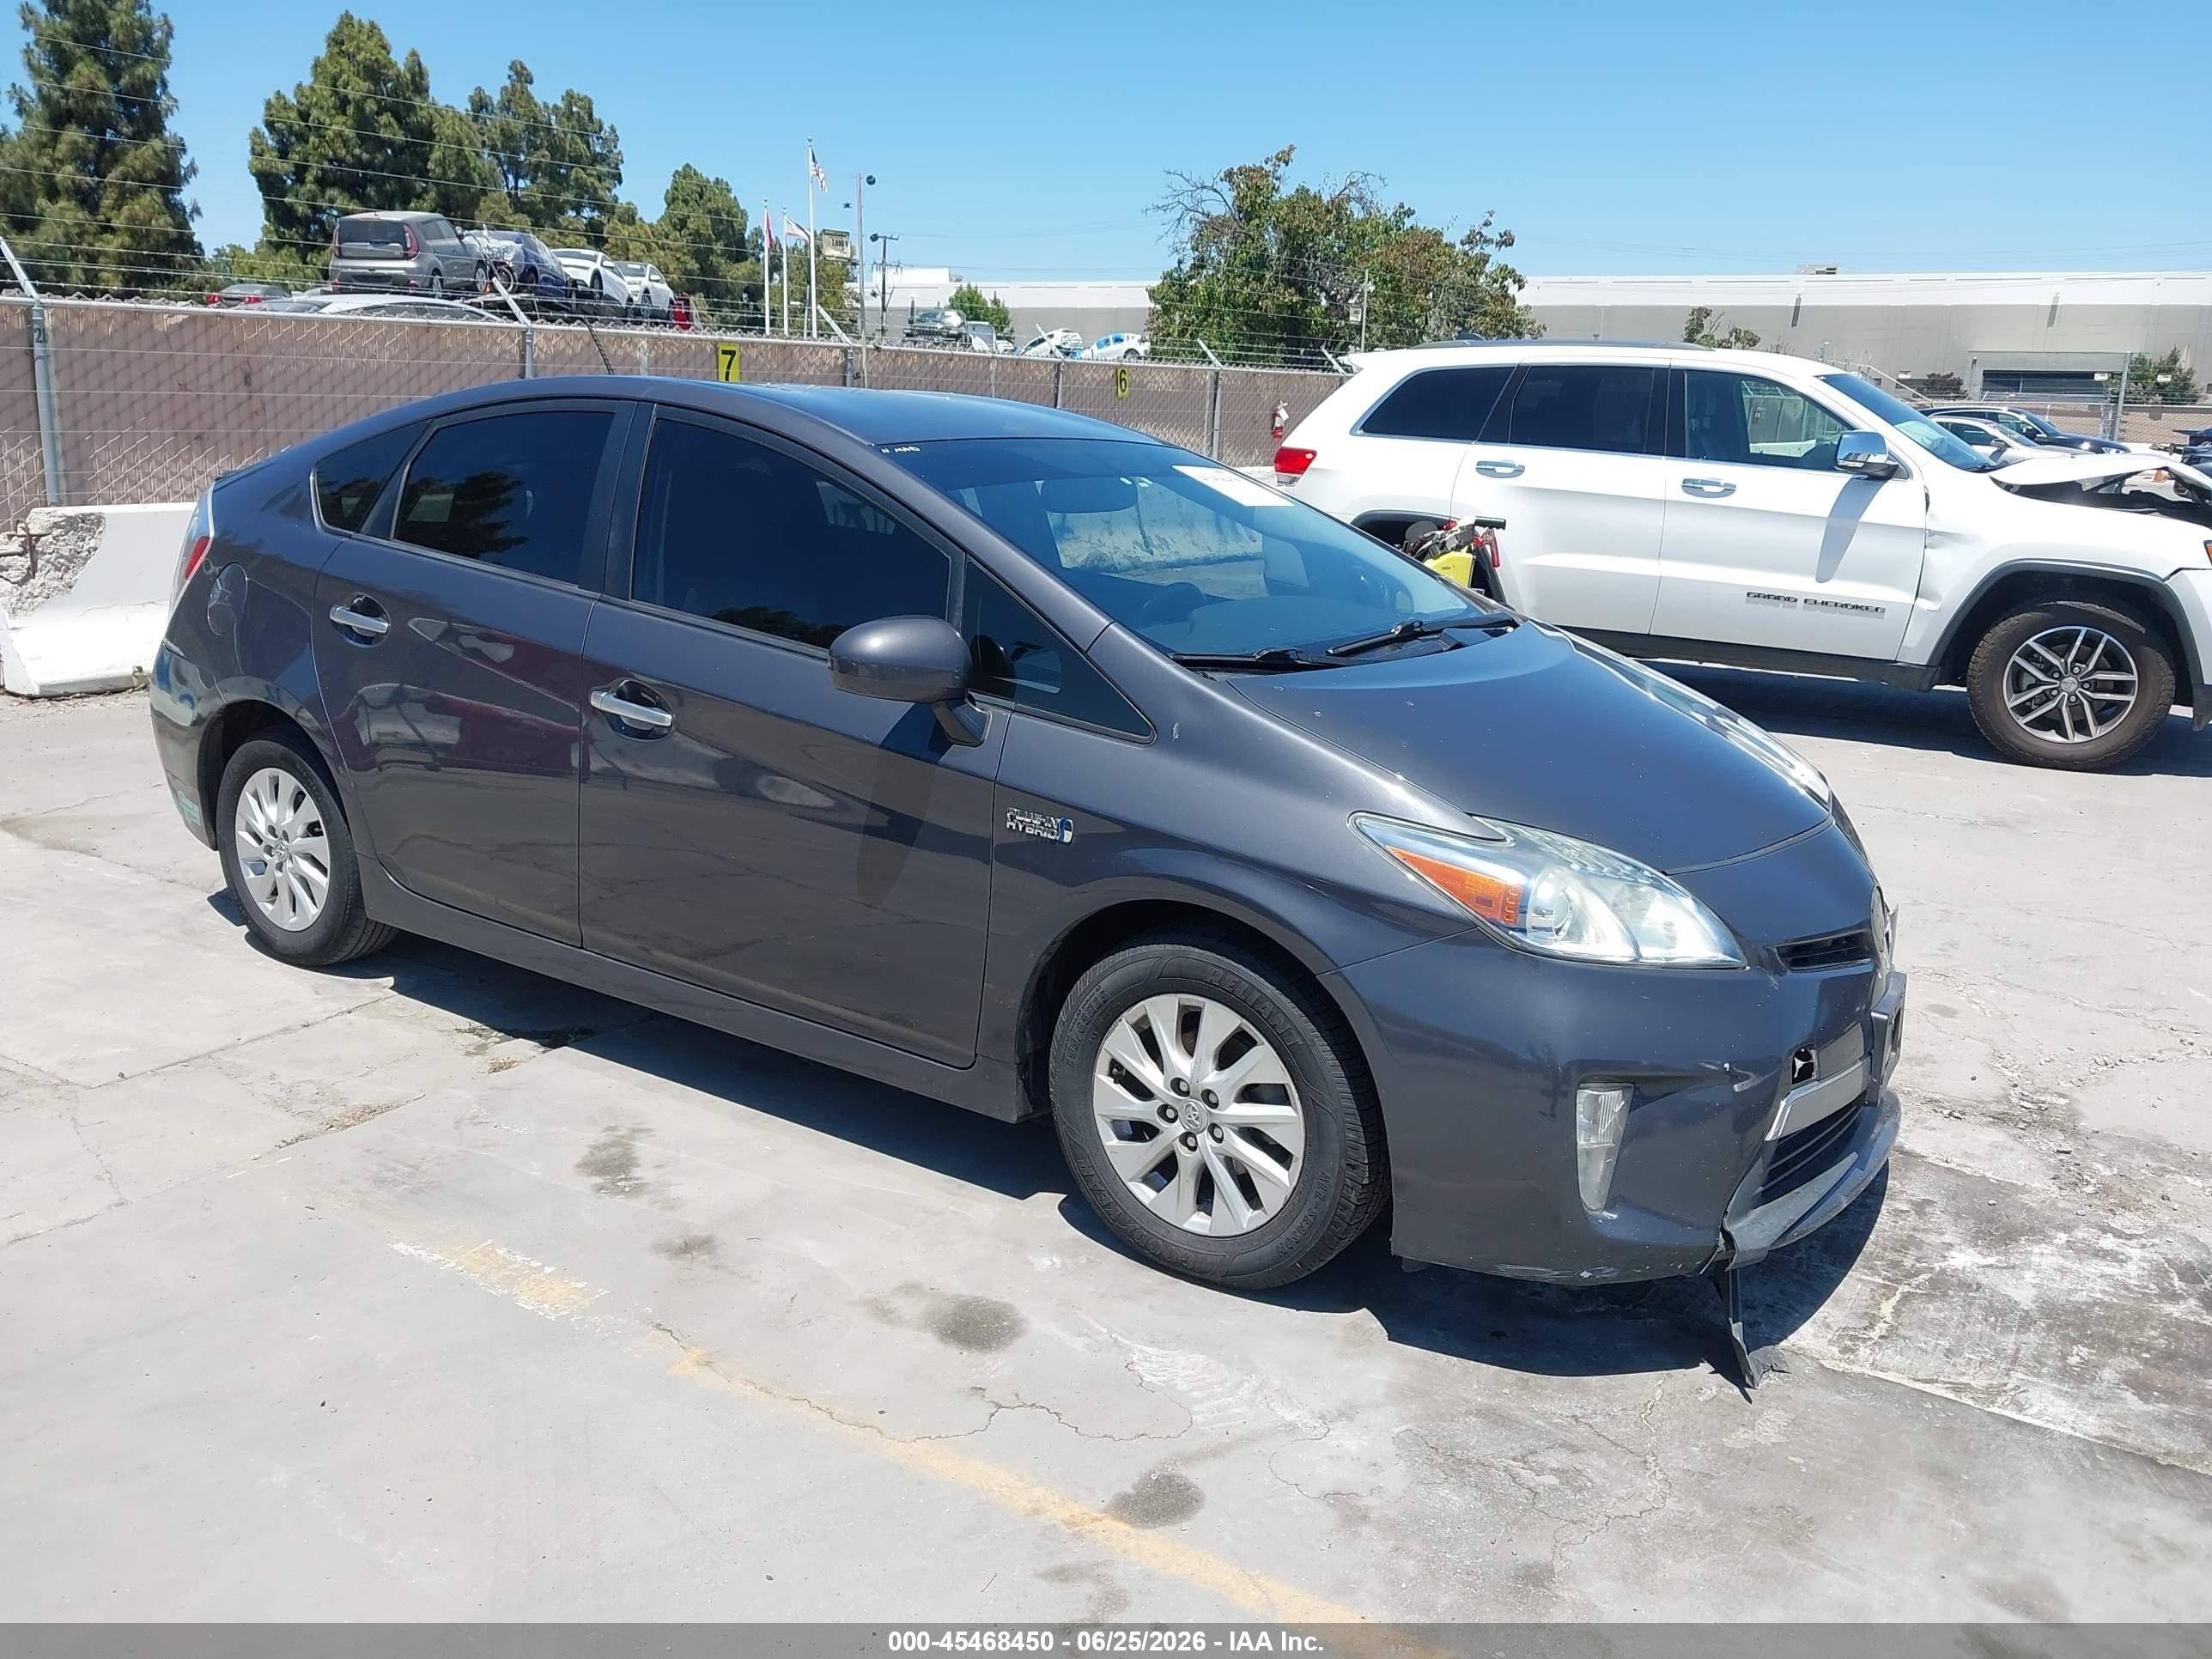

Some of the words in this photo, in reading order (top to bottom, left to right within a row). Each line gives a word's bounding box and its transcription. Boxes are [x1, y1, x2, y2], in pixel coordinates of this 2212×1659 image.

[720, 349, 737, 382] 7
[1119, 368, 1127, 393] 6
[1746, 591, 1798, 603] GRAND
[1803, 598, 1887, 613] CHEROKEE
[1006, 807, 1060, 830] PLUG-IN
[1006, 820, 1059, 840] HYBRID
[1208, 966, 1304, 1046] RELIANT
